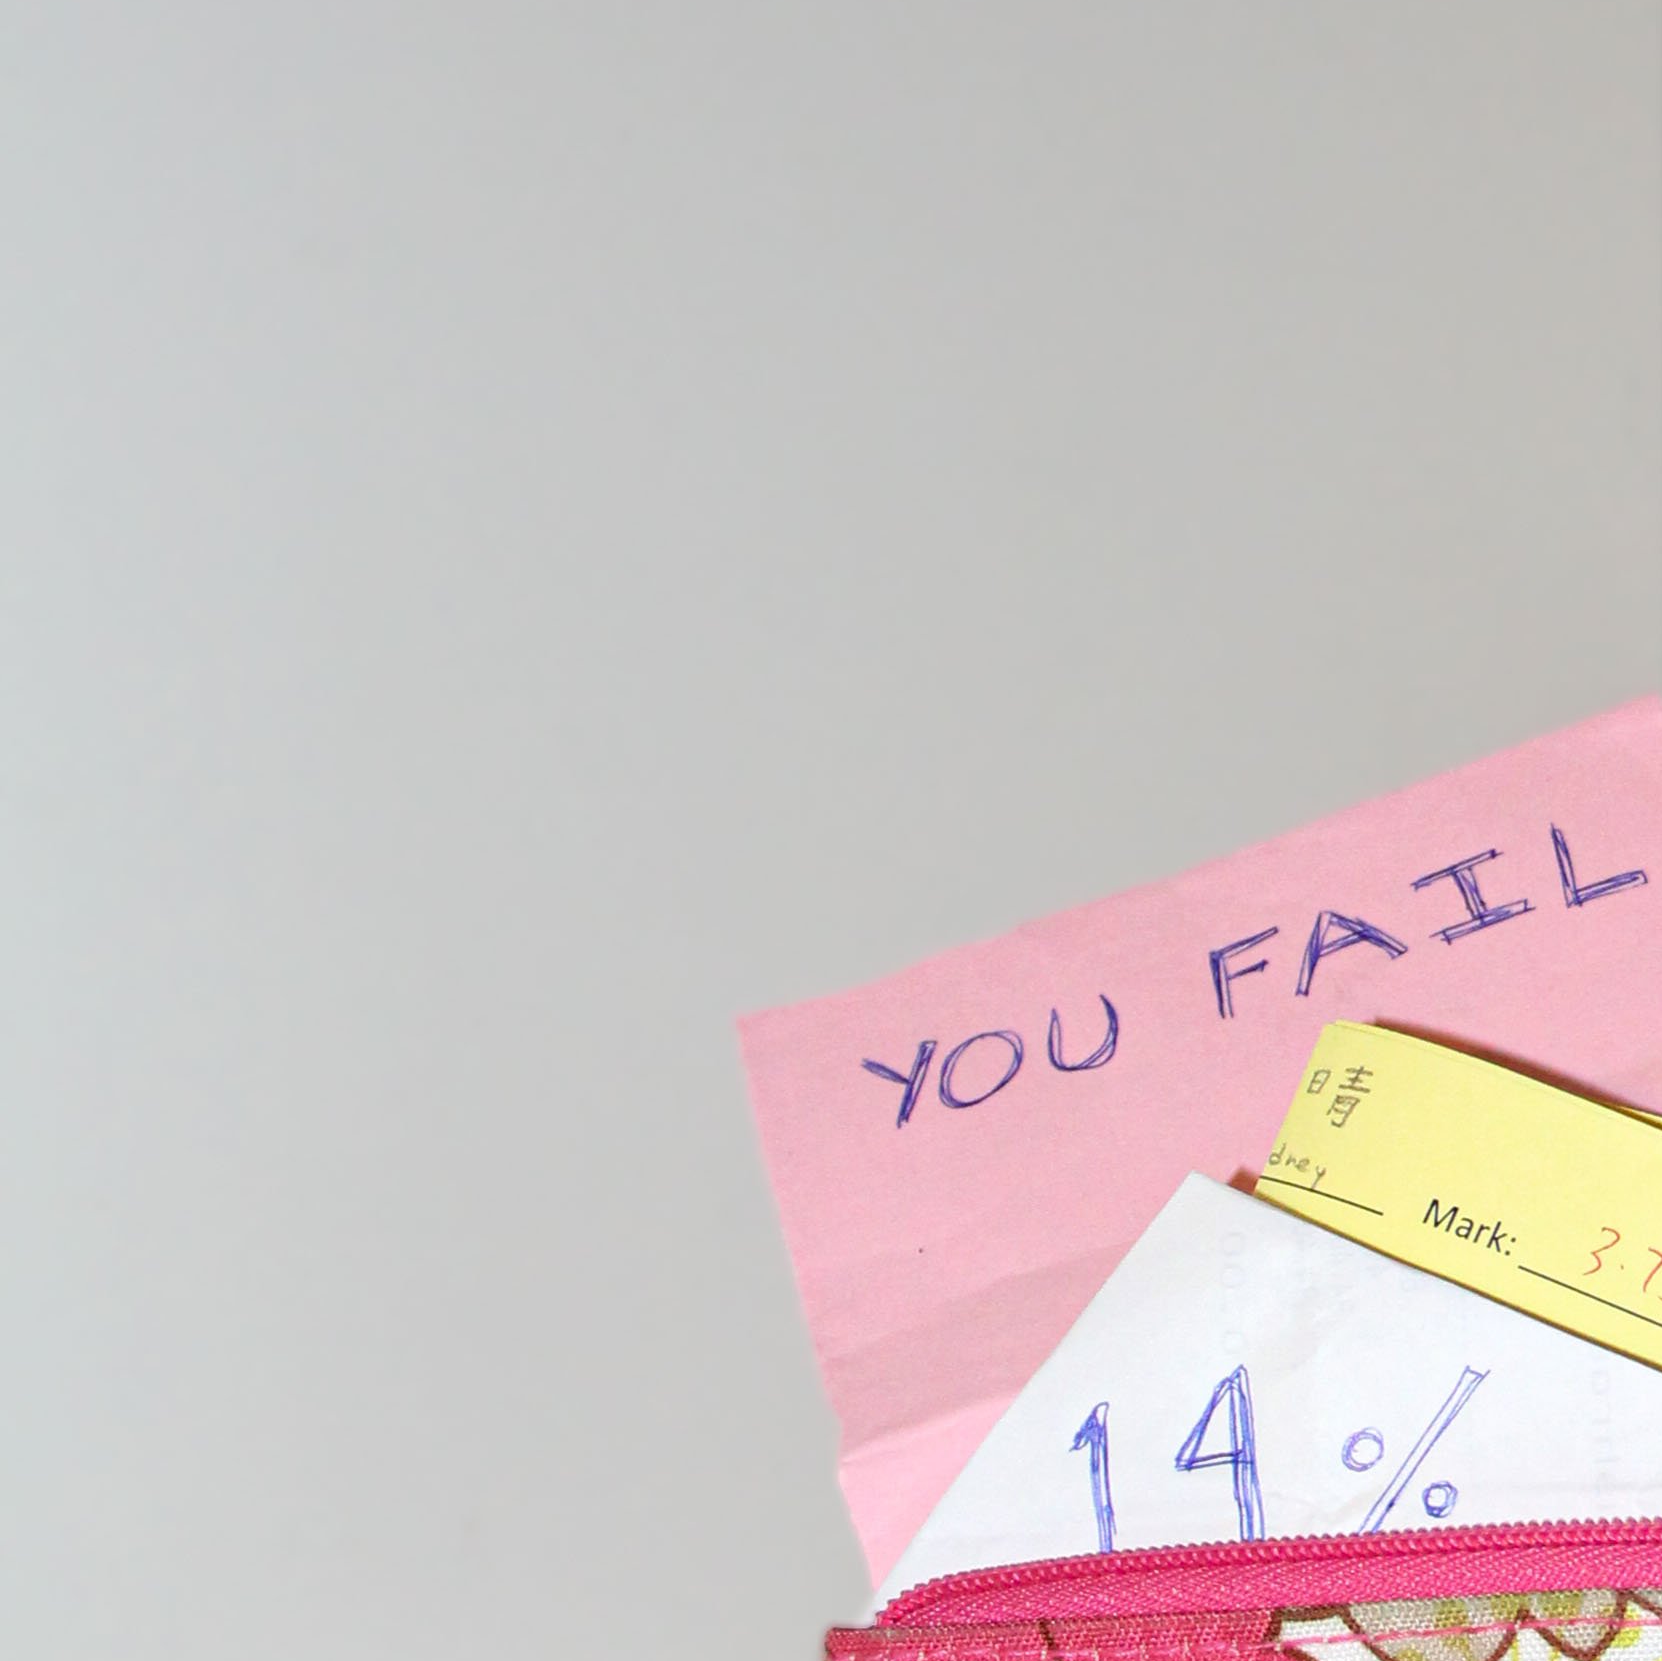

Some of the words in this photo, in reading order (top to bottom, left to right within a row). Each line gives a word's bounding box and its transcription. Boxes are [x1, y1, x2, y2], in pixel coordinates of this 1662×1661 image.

[860, 993, 1121, 1130] YOU
[1207, 821, 1648, 1019] FAIL
[1421, 1197, 1518, 1257] Mark:
